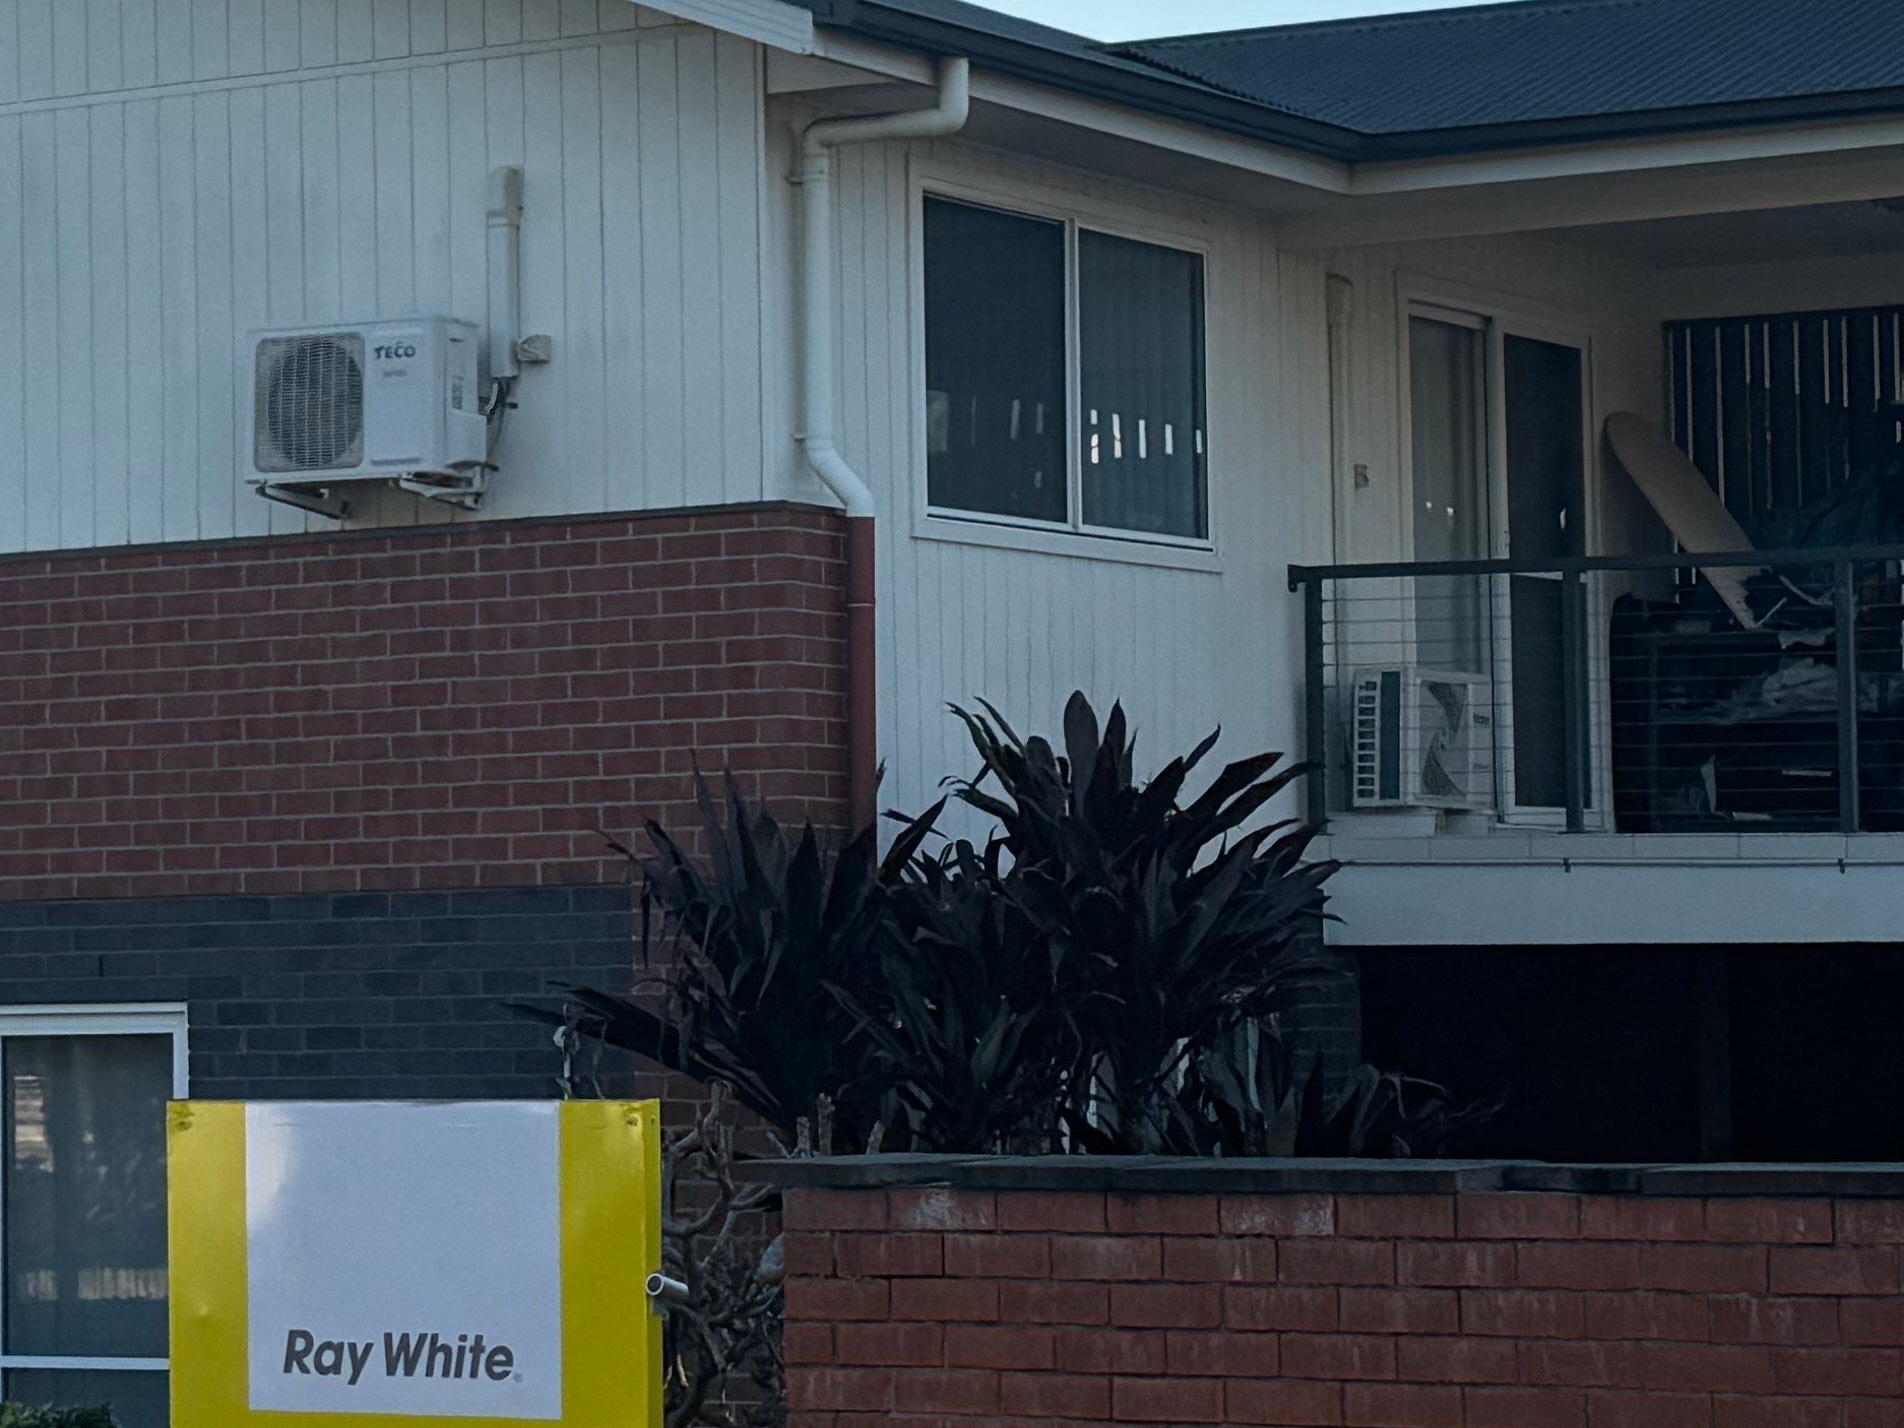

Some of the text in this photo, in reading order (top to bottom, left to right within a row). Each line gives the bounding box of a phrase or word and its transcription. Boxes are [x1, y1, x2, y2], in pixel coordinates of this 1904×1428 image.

[374, 342, 416, 359] TECO
[283, 1329, 514, 1386] Ray White
